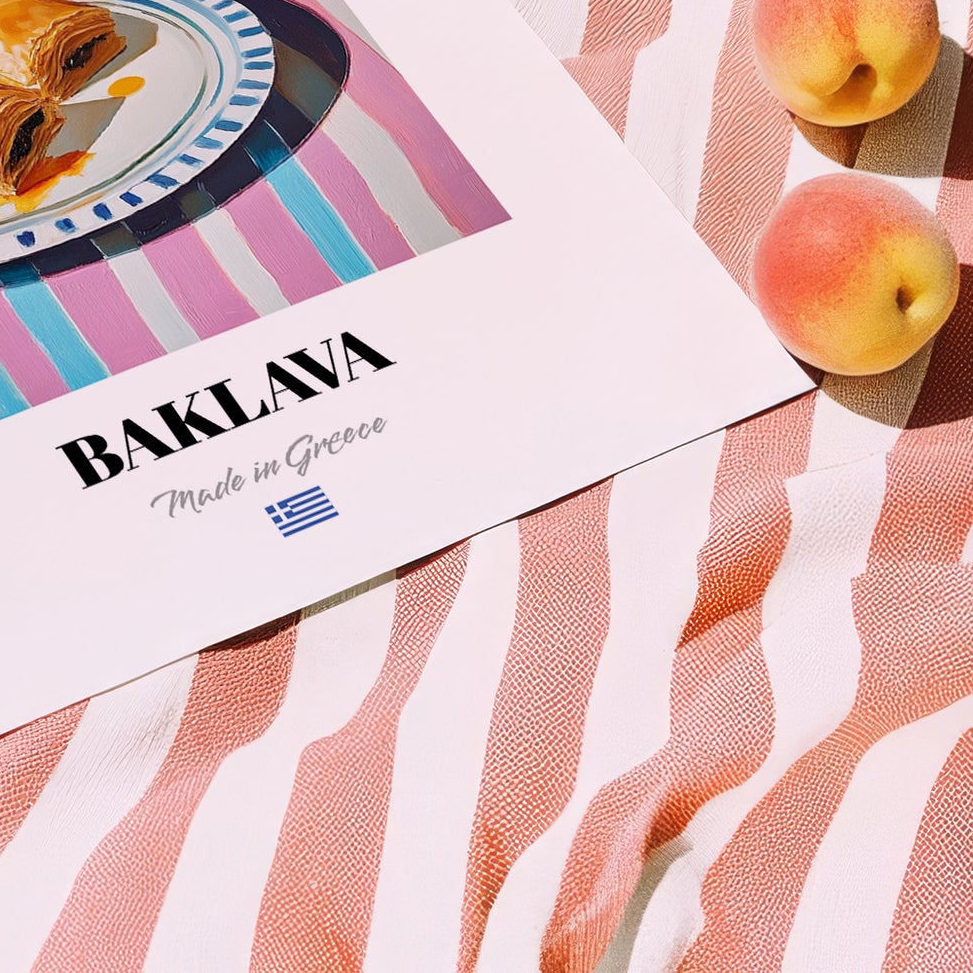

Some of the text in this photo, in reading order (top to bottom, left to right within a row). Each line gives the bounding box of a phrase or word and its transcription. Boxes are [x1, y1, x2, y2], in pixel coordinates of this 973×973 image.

[55, 331, 397, 490] BAKLAVA
[150, 418, 388, 519] Made in Greece
